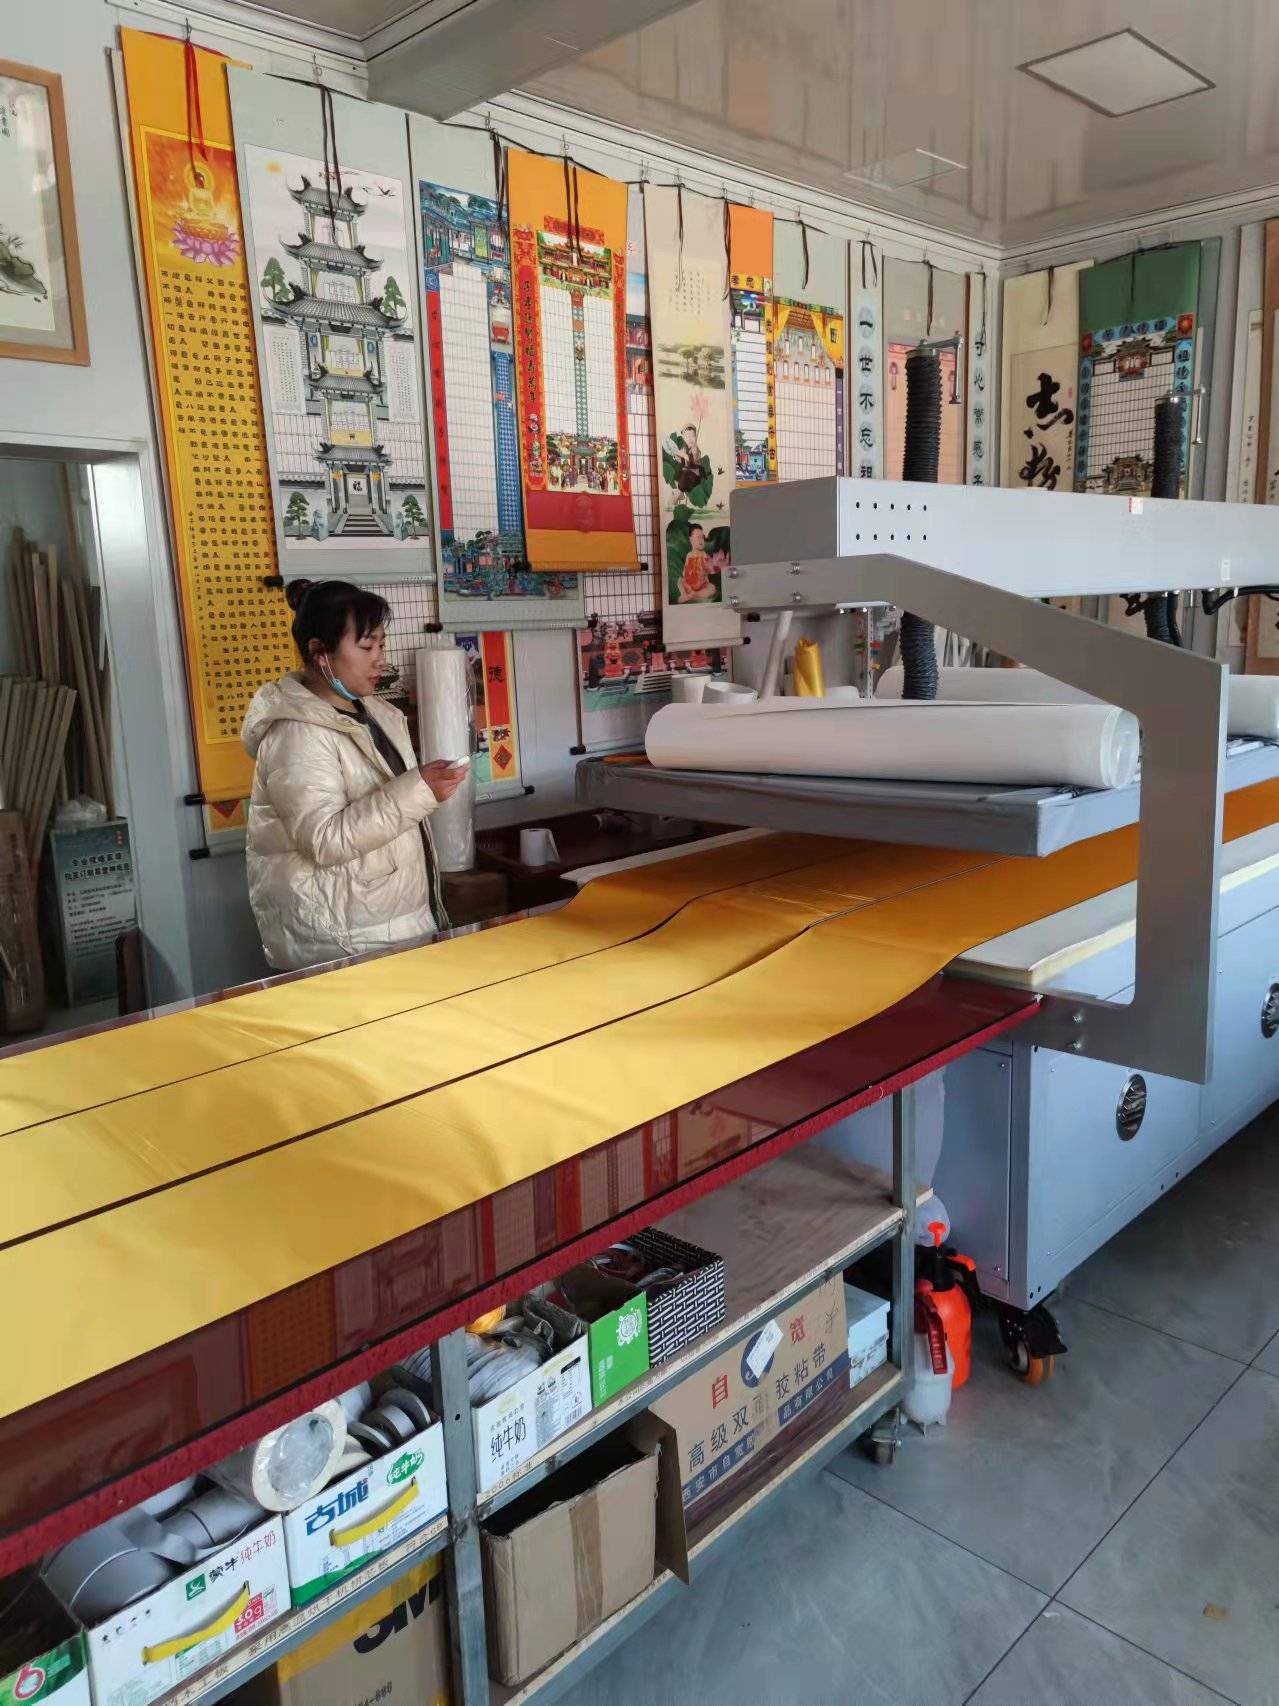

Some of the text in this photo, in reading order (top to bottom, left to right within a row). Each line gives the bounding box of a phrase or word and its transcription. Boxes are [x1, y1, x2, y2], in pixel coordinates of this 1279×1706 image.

[711, 1374, 728, 1409] 自
[488, 1416, 526, 1463] 纯牛奶
[208, 1554, 240, 1583] 蒙牛
